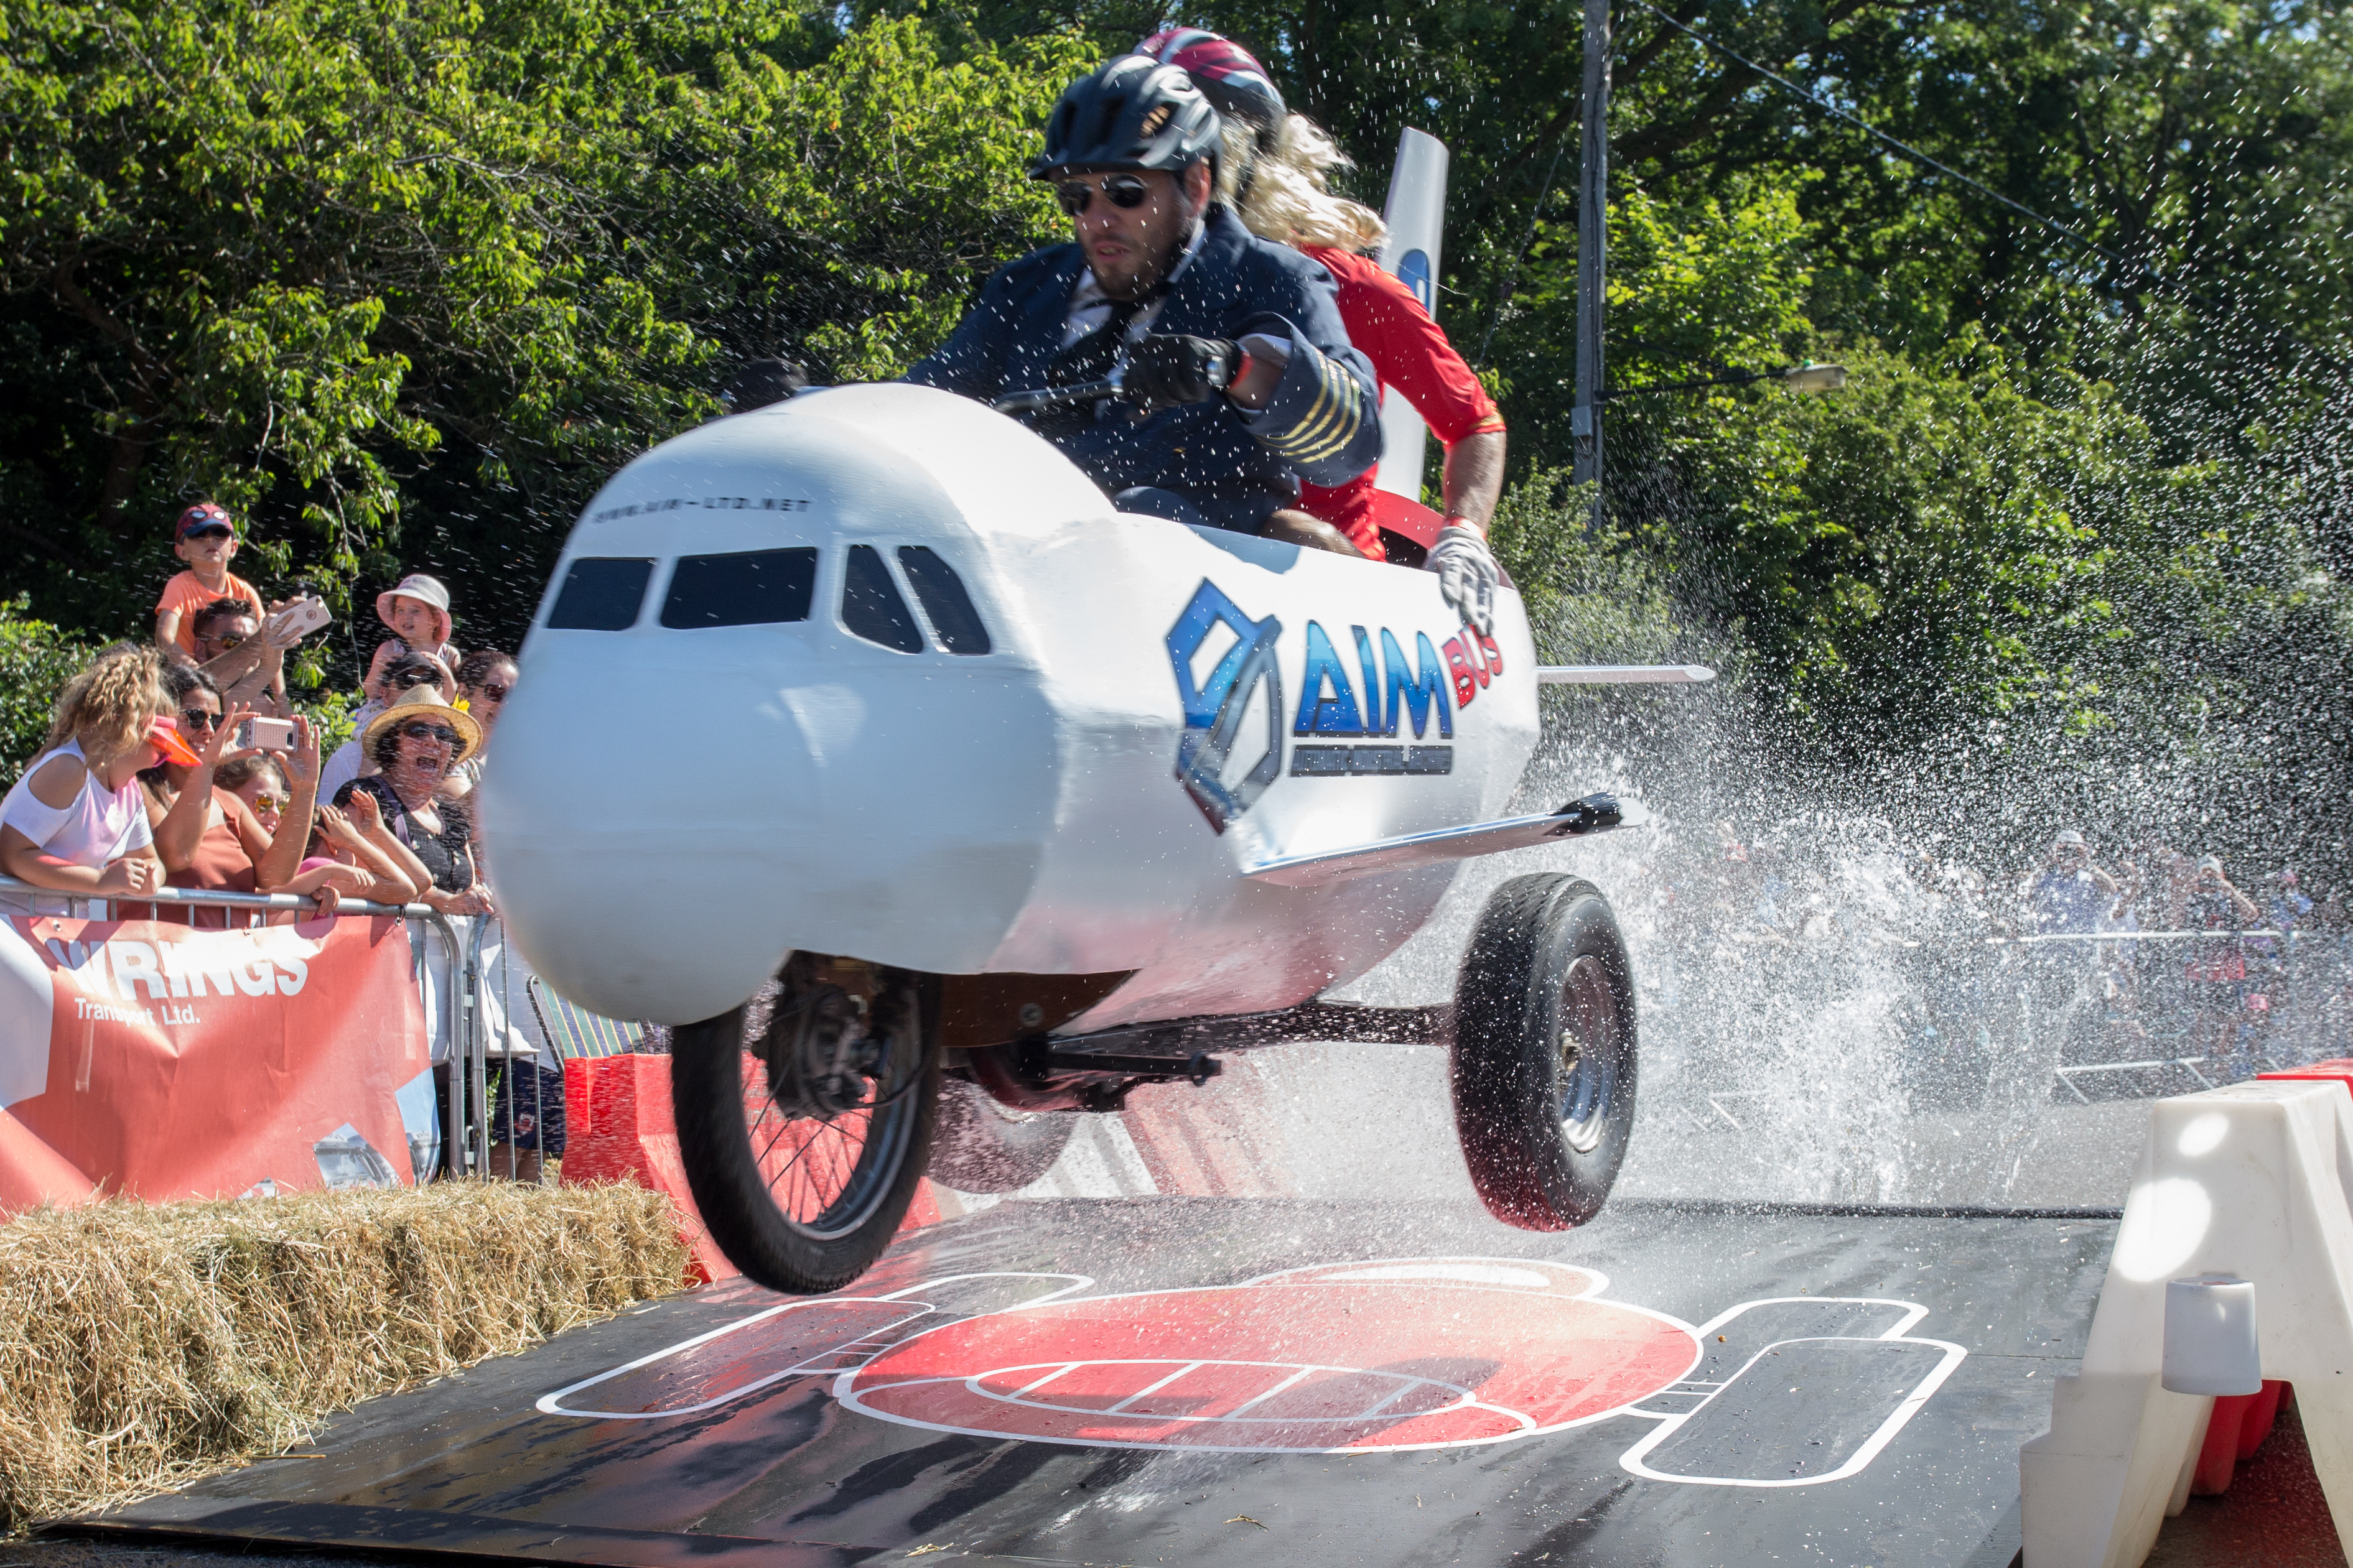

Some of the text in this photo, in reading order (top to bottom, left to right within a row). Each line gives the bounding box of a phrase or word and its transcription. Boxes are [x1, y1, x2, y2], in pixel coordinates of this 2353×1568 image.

[1293, 619, 1453, 740] AIM
[75, 997, 200, 1026] Transport Ltd.
